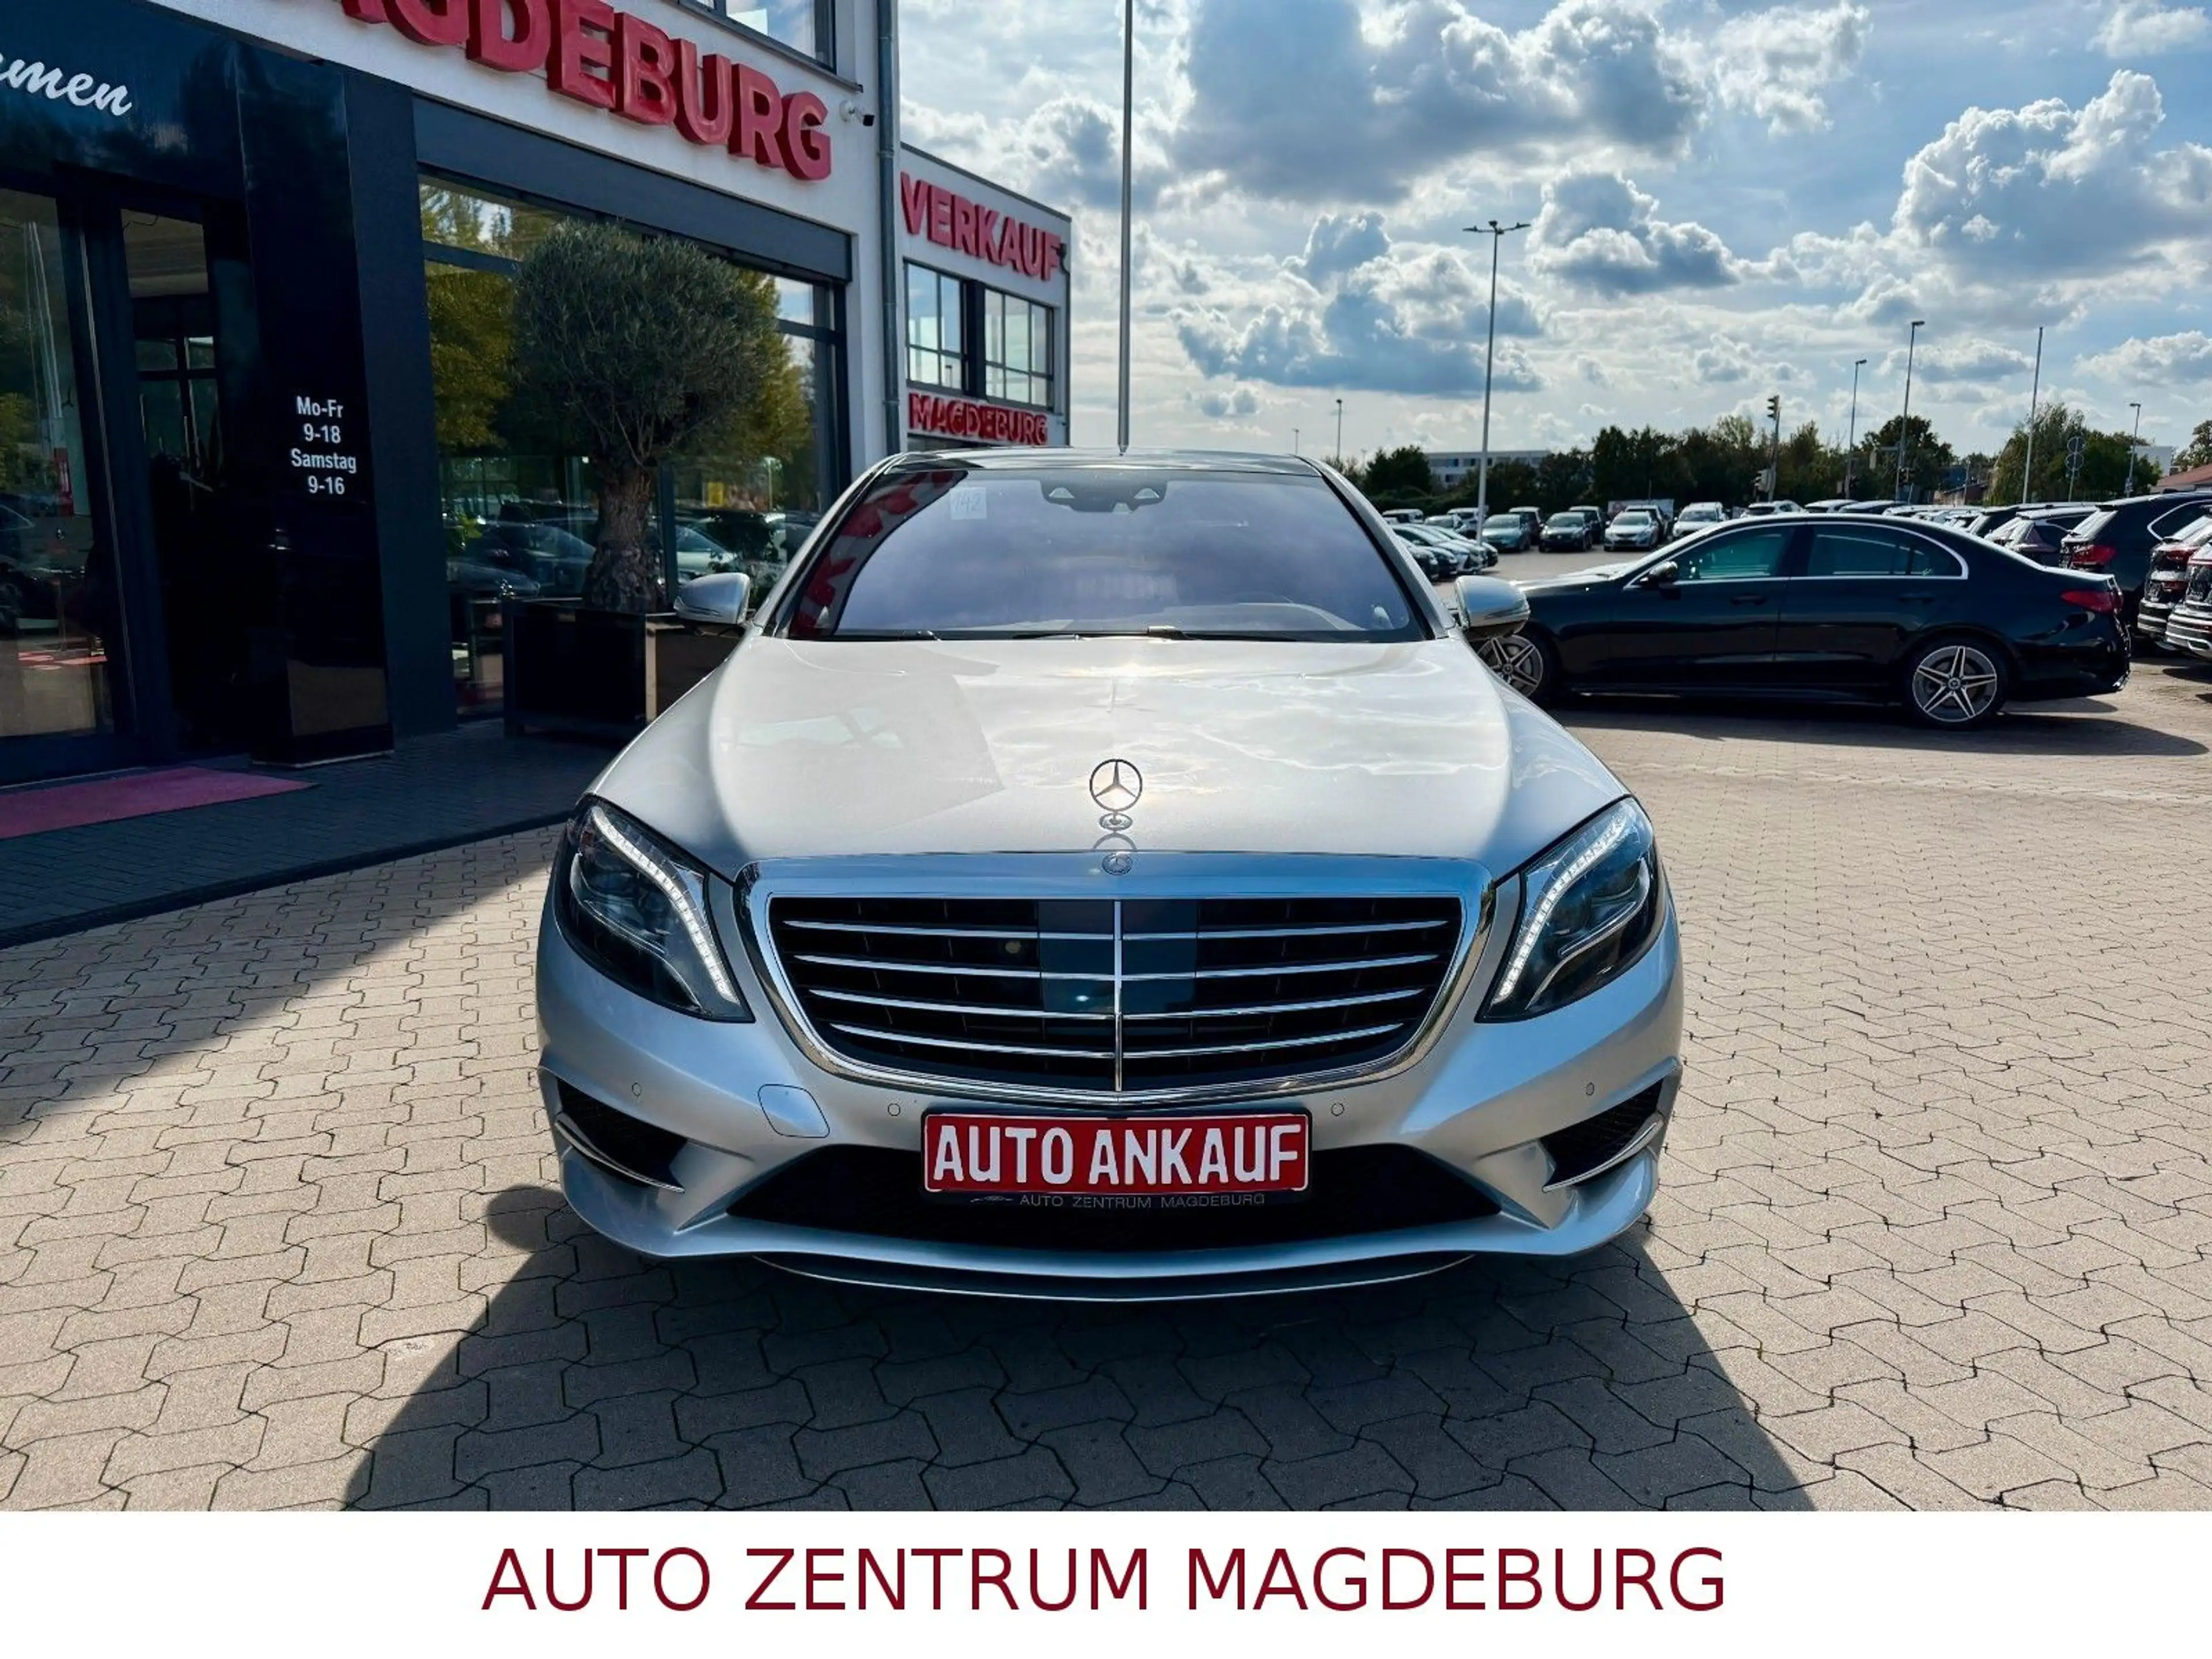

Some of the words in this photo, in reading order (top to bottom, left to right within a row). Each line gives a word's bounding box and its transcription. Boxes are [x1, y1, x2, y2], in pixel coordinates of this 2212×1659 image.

[0, 52, 132, 116] men
[900, 173, 1062, 280] VERKAUF
[296, 396, 343, 418] Mo-Fr
[908, 393, 1048, 446] MAGDEBURG
[303, 423, 342, 444] 9-18
[290, 448, 357, 474] Samstag
[308, 475, 345, 495] 9-16
[933, 1124, 1074, 1184] AUTO
[1088, 1124, 1302, 1185] ANKAUF
[1020, 1194, 1064, 1207] AUTO
[1072, 1196, 1152, 1209] ZENTRUM
[1161, 1193, 1265, 1208] MAGDEBURG
